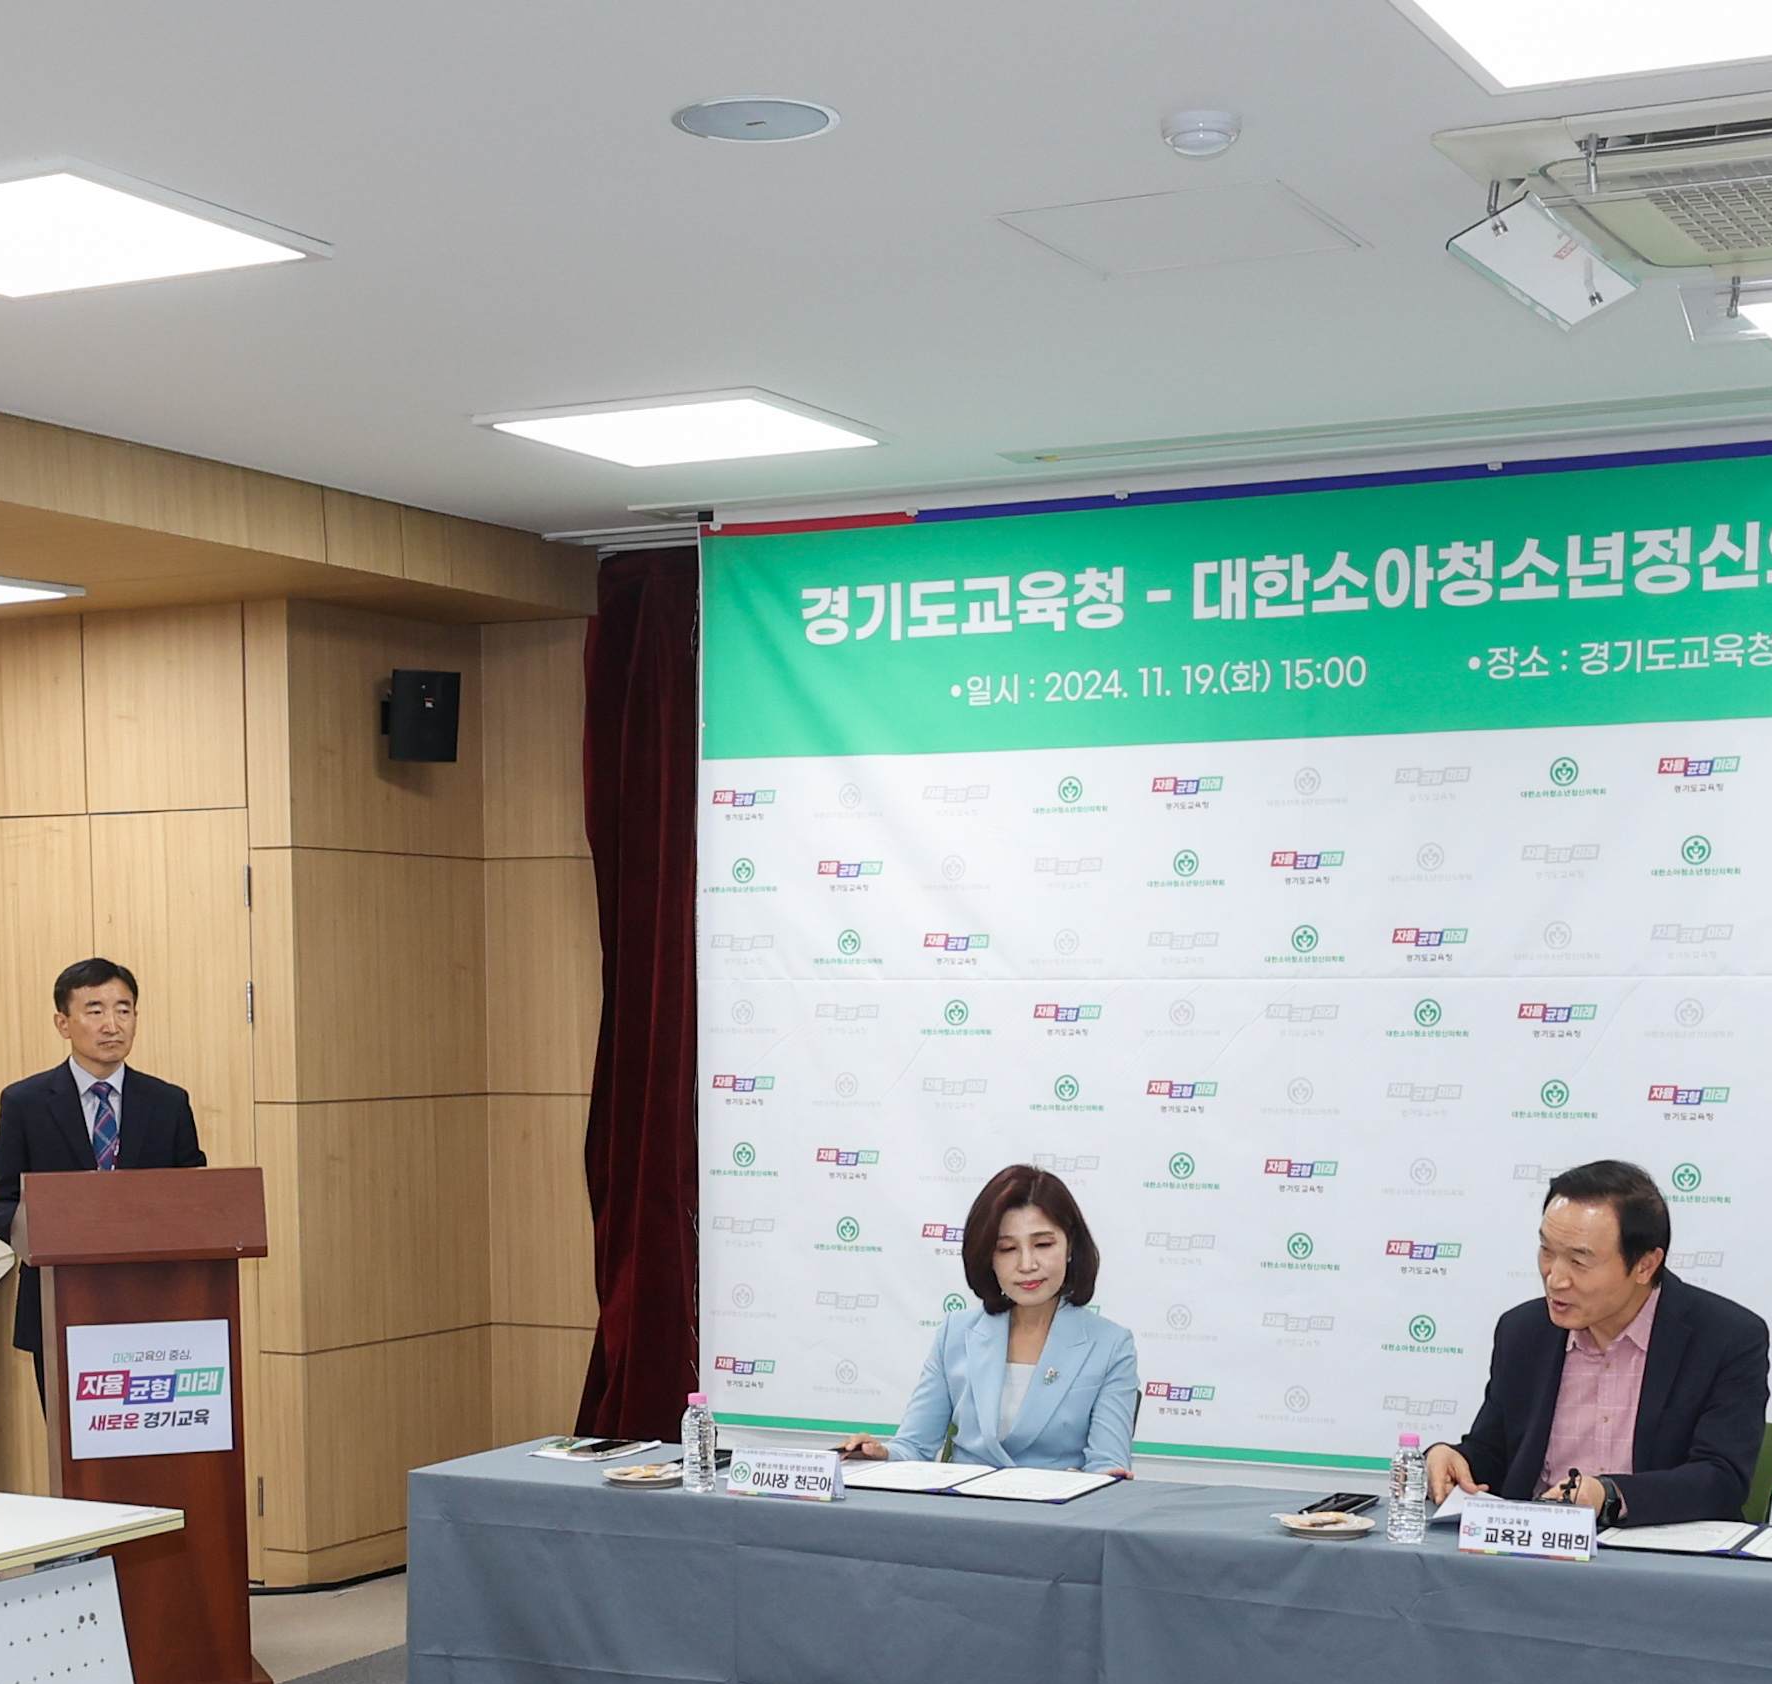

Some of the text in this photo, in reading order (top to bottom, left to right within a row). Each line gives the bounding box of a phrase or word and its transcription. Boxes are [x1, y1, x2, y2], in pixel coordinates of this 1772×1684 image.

[801, 567, 1127, 648] 경기도교육청
[1146, 589, 1172, 604] -
[1487, 645, 1550, 681] 장소
[967, 675, 1020, 706] 일시
[1045, 670, 1129, 702] 2024.
[1138, 667, 1172, 697] 11.
[1182, 660, 1272, 697] 19.(화)
[1281, 656, 1367, 690] 15:00
[1660, 757, 1738, 776] 자율 균형 미래
[1154, 777, 1221, 794] 자율 균형 미래
[1674, 783, 1724, 793] 경기도교육청
[1273, 852, 1342, 868] 자율 균형 미래
[1285, 876, 1330, 885] 경기도교육청
[1396, 929, 1466, 946] 자율 균형 미래
[1406, 953, 1453, 962] 경기도교육청
[1036, 1005, 1100, 1021] 자율 균형 미래
[1522, 1004, 1595, 1022] 자율 균형 미래
[1532, 1030, 1581, 1038] 경기도교육청
[1149, 1081, 1216, 1098] 자율 균형 미래
[1652, 1086, 1728, 1105] 자율 균형 미래
[1663, 1112, 1714, 1121] 경기도교육청
[1268, 1160, 1336, 1177] 자율 균형 미래
[1278, 1184, 1324, 1193] 경기도교육청
[1390, 1241, 1460, 1259] 자율 균형 미래
[1400, 1266, 1447, 1275] 경기도교육청
[113, 1349, 192, 1363] 미래교육의 중심,
[81, 1370, 220, 1401] 자율 균형 미래
[1148, 1383, 1213, 1401] 자율 균형 미래
[88, 1409, 210, 1431] 새로운 경기교육
[752, 1472, 833, 1492] 이사장 천근아
[1487, 1517, 1530, 1527] 경기도교육청
[1484, 1527, 1590, 1552] 교육감 임태희
